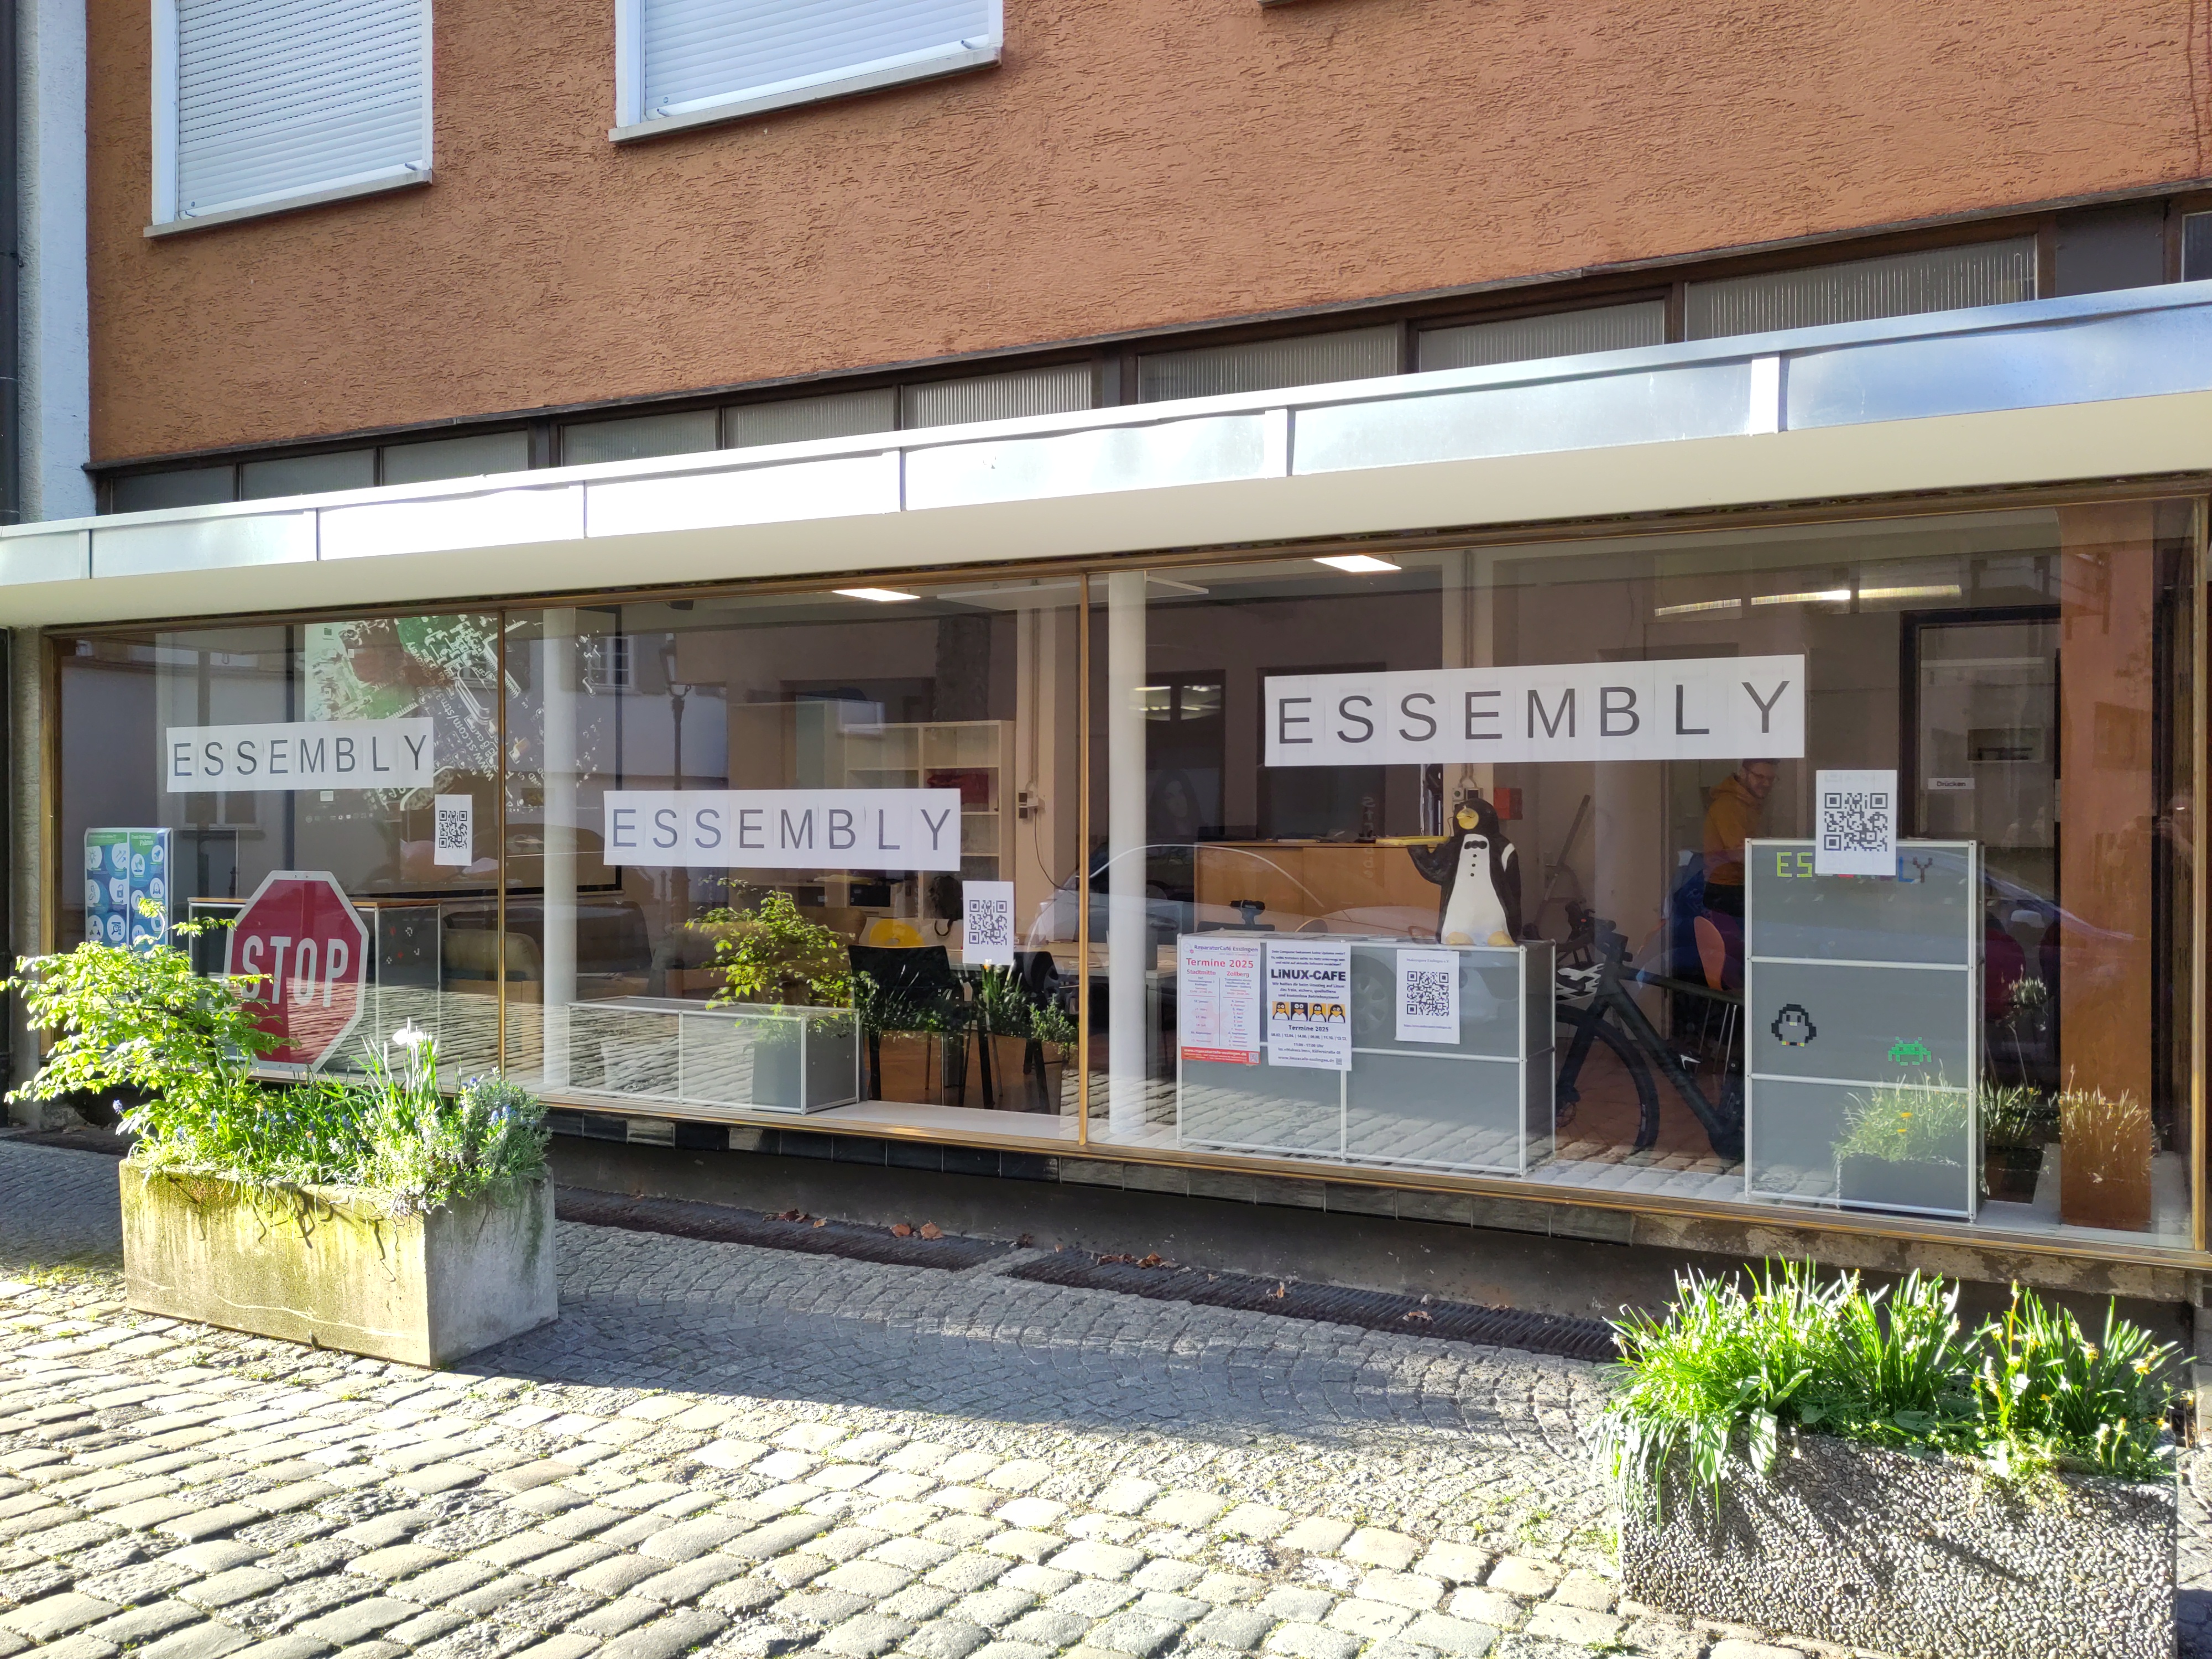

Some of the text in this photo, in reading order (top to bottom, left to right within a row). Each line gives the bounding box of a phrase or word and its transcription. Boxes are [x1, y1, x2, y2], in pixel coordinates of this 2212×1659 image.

[1279, 681, 1790, 744] ESSEMBLY
[173, 734, 427, 777] ESSEMBLY
[612, 808, 951, 851] ESSEMBLY
[1776, 852, 1933, 884] ESLY
[240, 935, 349, 1008] STOP
[1186, 958, 1254, 968] Termine 2025
[1271, 968, 1346, 982] LiNUX-CAFE
